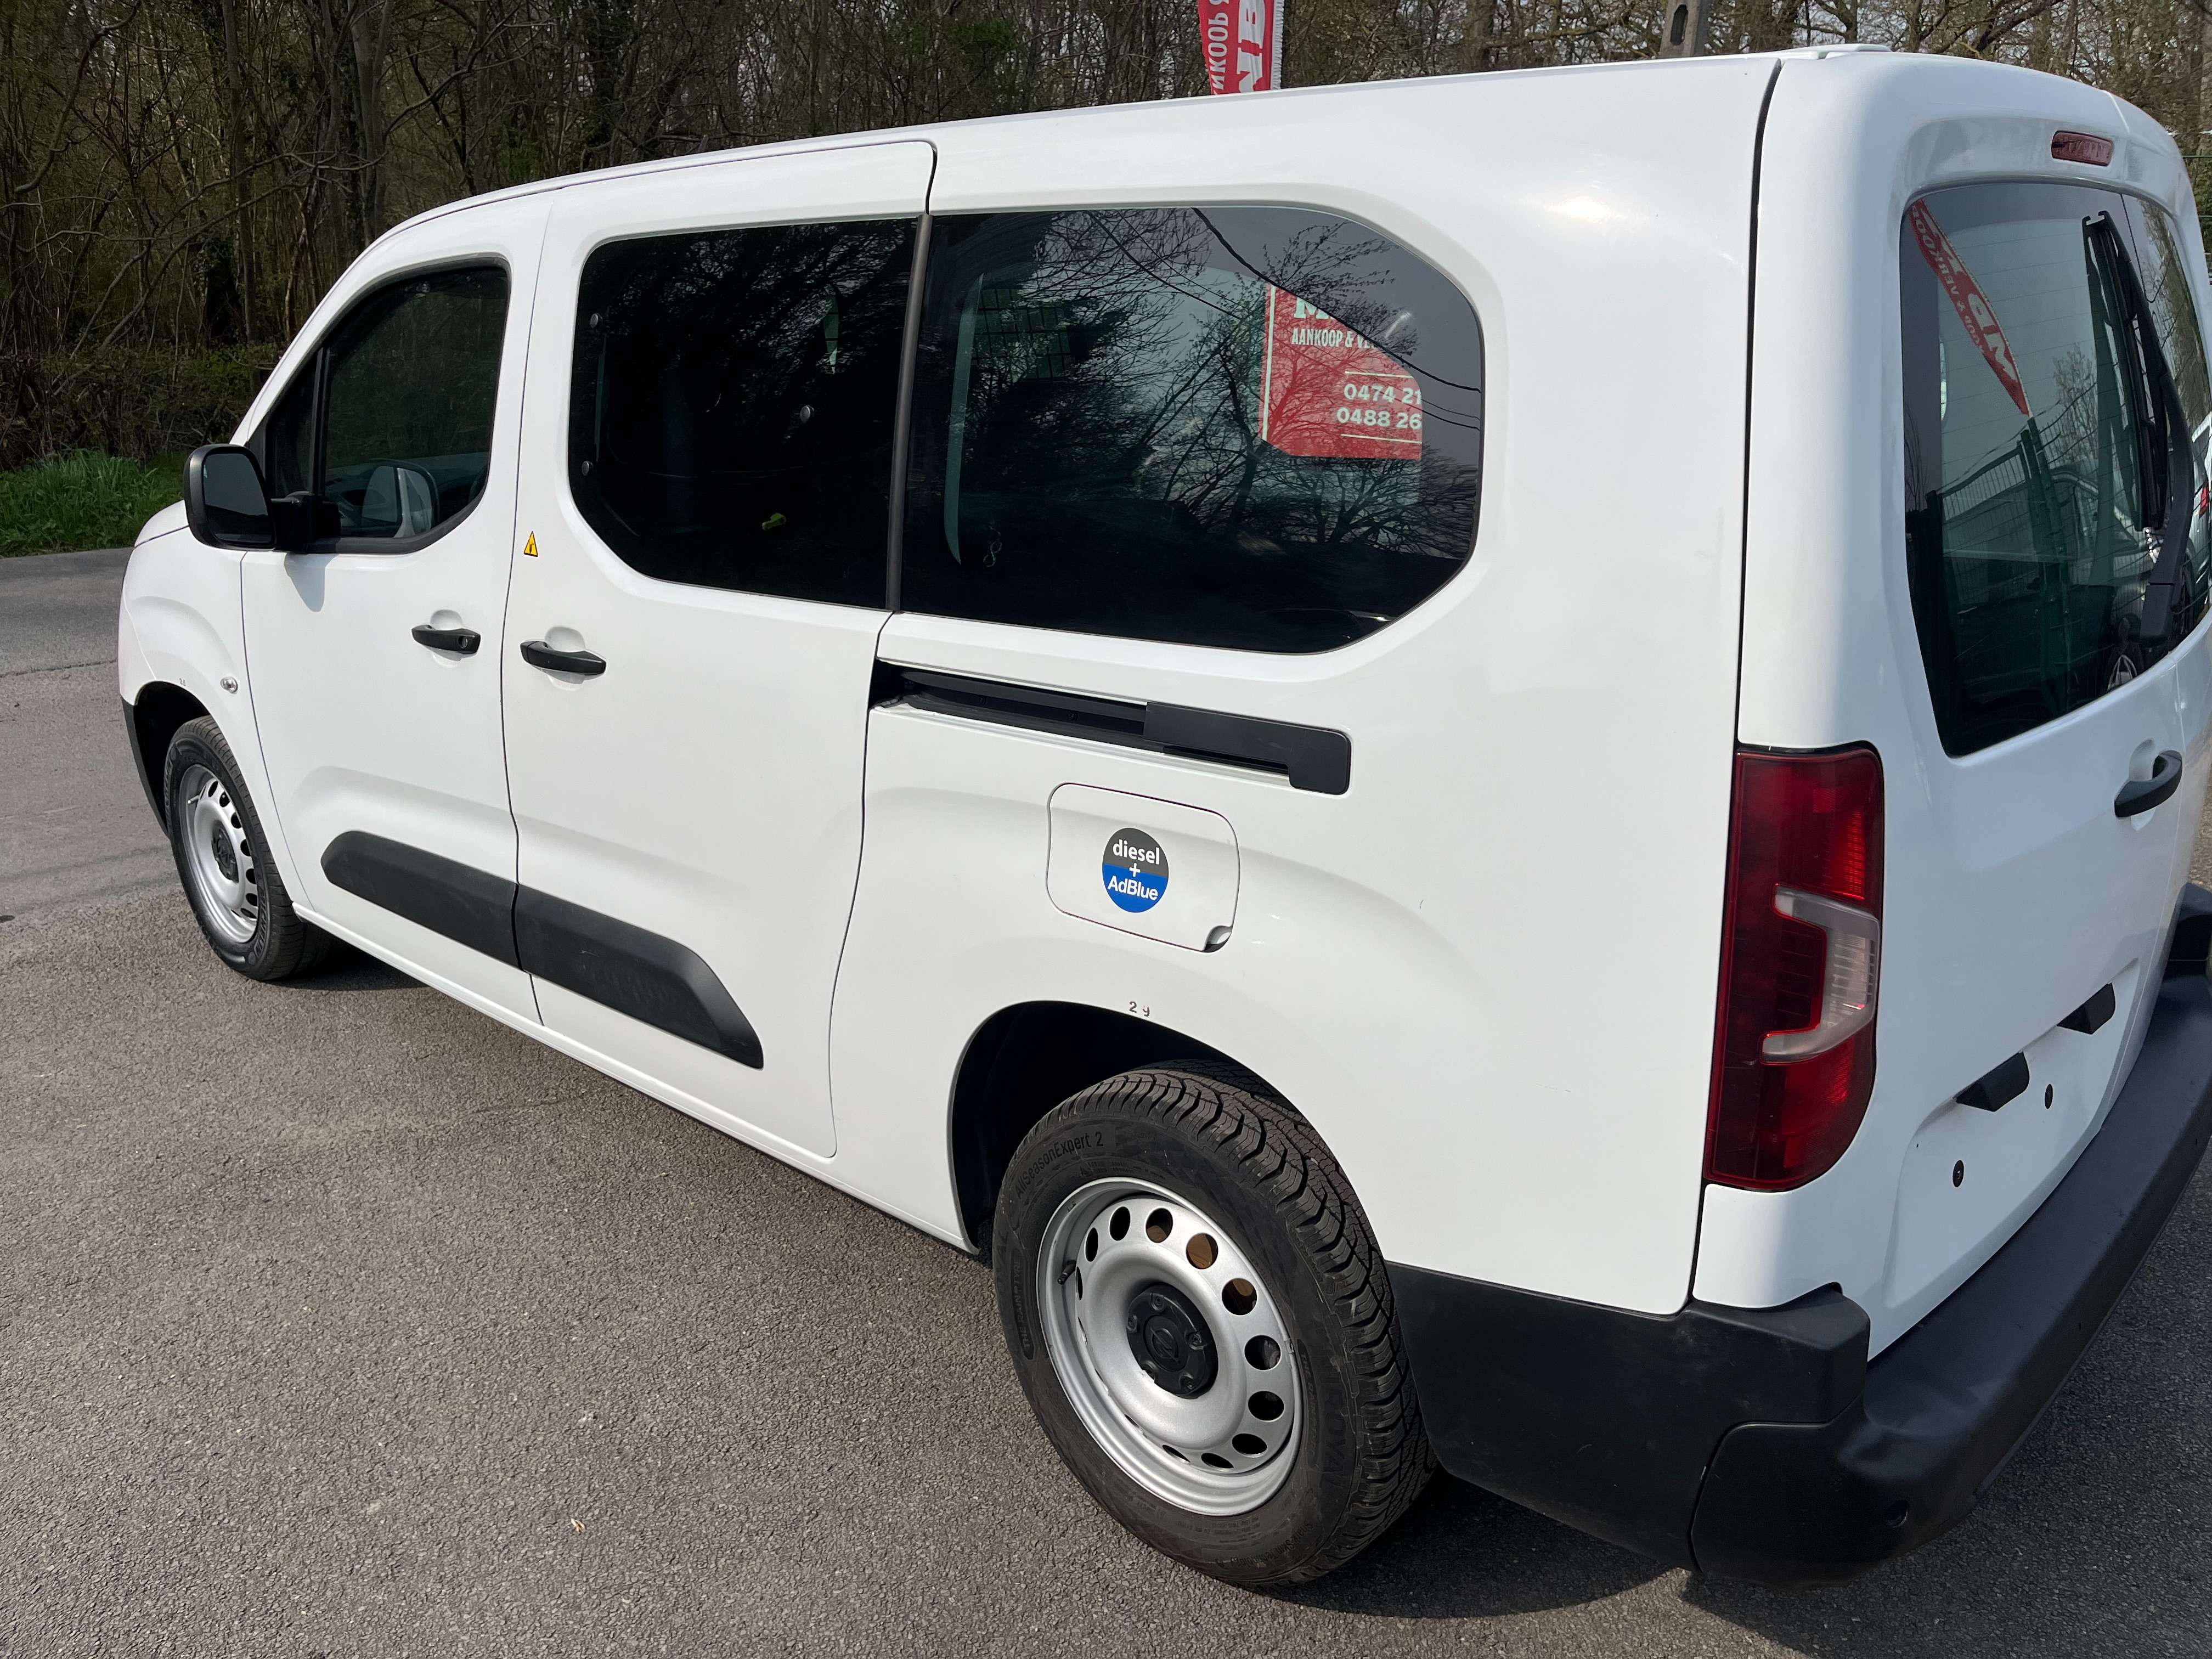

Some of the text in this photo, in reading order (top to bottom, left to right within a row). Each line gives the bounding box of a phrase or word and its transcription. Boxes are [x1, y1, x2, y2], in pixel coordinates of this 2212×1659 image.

[1291, 328, 1344, 347] AANKOOP
[1345, 331, 1354, 348] &
[1344, 383, 1422, 404] 0474 21
[1336, 407, 1422, 430] 0488 26
[1113, 839, 1160, 865] diesel
[1107, 876, 1158, 900] AdBlue
[1017, 1132, 1092, 1199] AllSeasonExpert
[1095, 1131, 1103, 1146] 2
